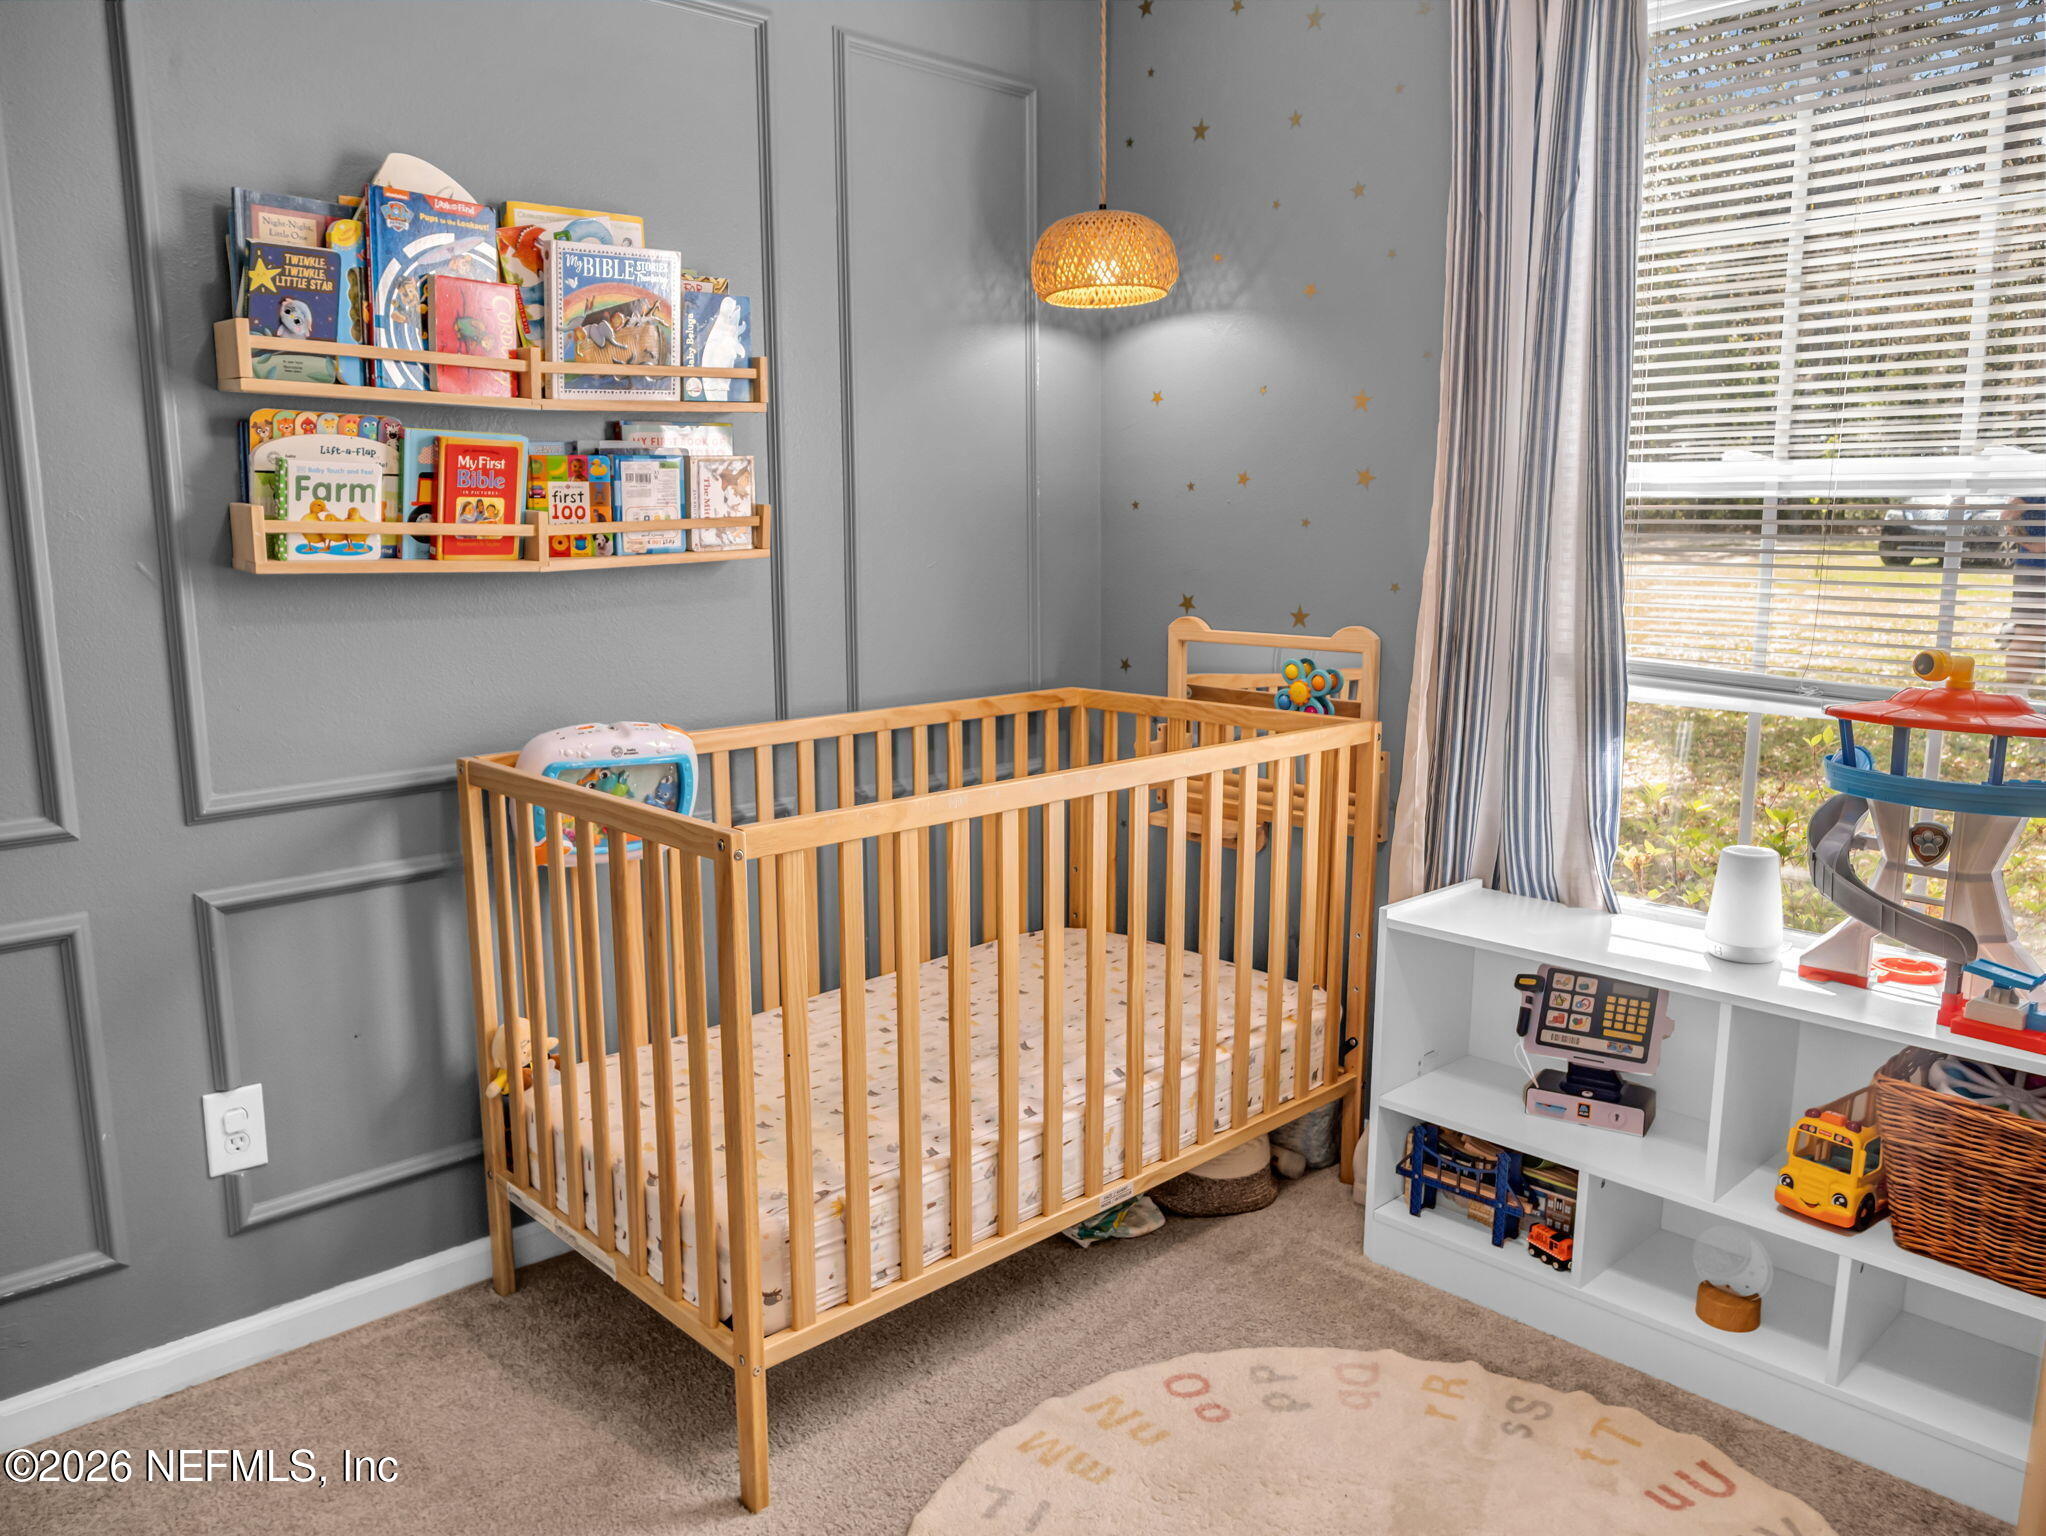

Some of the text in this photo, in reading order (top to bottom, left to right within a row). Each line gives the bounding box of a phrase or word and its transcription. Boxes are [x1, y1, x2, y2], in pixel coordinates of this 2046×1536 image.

[419, 212, 438, 223] Pups
[565, 253, 583, 273] My
[583, 256, 635, 280] BIBLE
[275, 275, 334, 291] LITTLE STAR
[685, 313, 697, 345] Beluga
[457, 455, 506, 470] My First
[295, 474, 376, 503] Farm
[456, 469, 506, 489] Bible
[703, 478, 711, 497] The
[552, 489, 584, 503] first
[551, 503, 586, 520] 100
